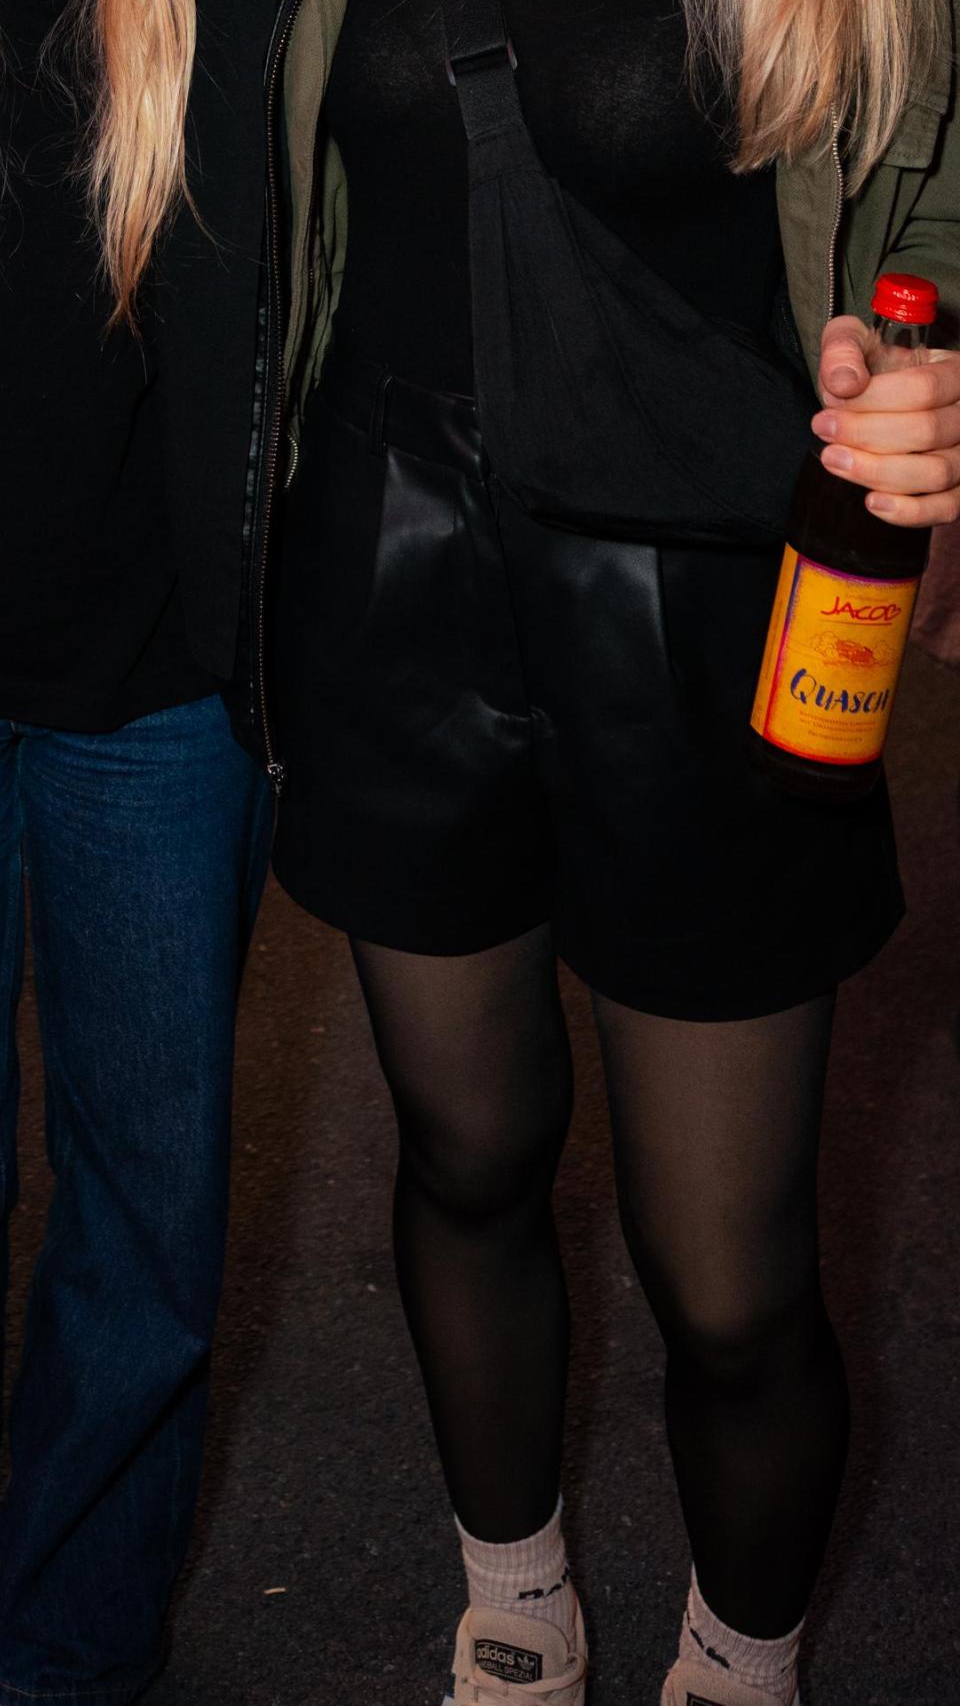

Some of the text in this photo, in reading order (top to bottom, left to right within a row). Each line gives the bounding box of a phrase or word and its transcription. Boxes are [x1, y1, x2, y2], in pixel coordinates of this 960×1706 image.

[820, 596, 902, 621] JACOB
[790, 668, 889, 713] QUASCH
[476, 1645, 516, 1666] adidas
